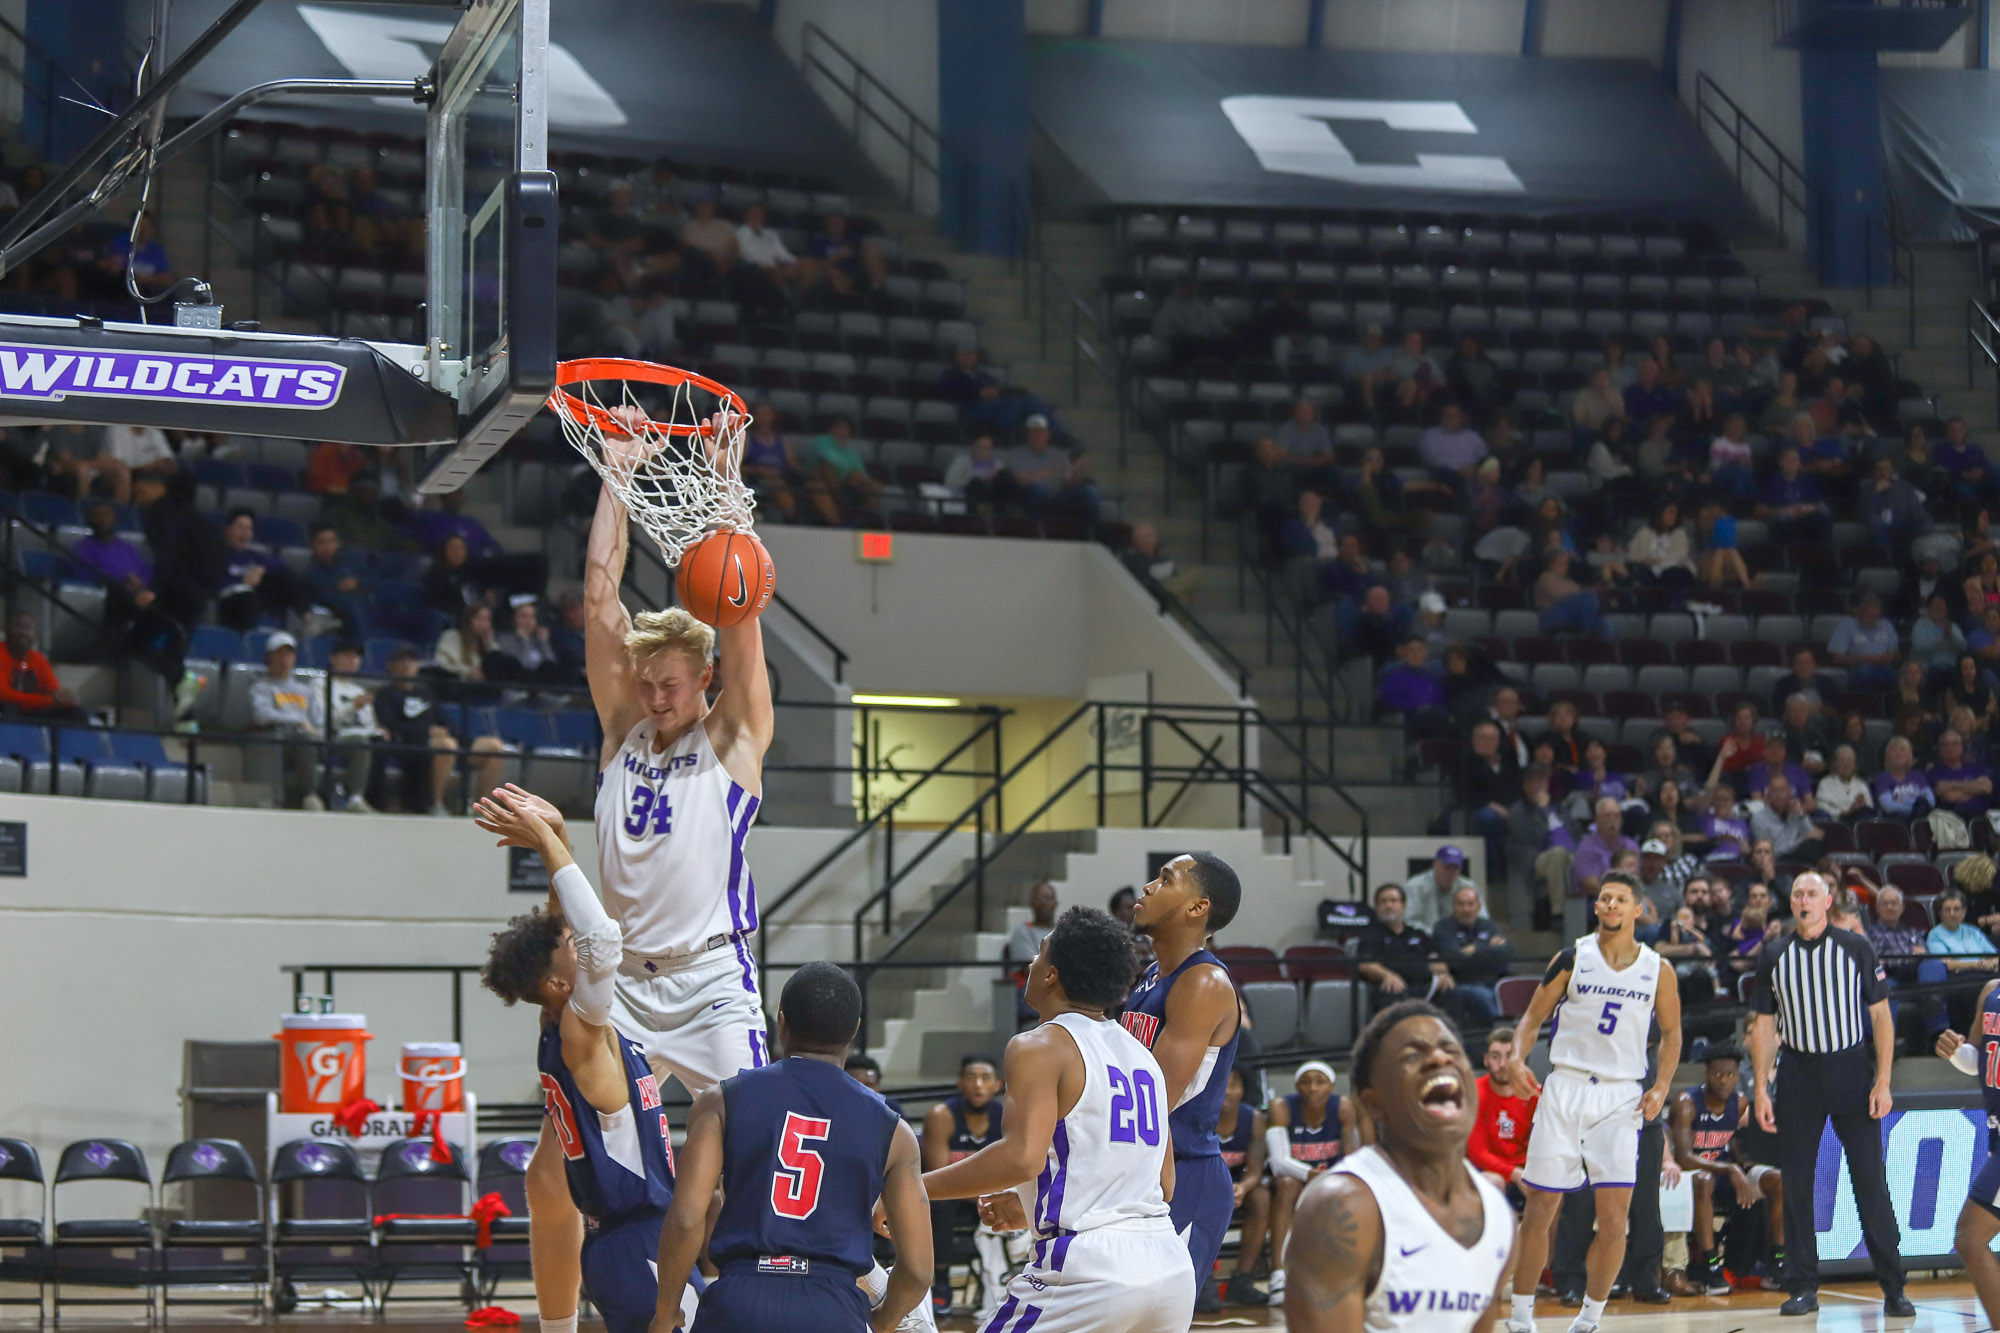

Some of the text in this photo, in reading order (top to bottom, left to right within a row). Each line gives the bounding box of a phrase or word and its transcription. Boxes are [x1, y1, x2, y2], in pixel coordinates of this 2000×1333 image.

[0, 351, 336, 401] WILDCATS
[624, 785, 672, 836] 34
[1577, 984, 1650, 1002] WILDCATS
[1597, 1001, 1622, 1036] 5
[311, 1046, 340, 1077] G
[1107, 1064, 1160, 1147] 20
[771, 1111, 831, 1220] 5
